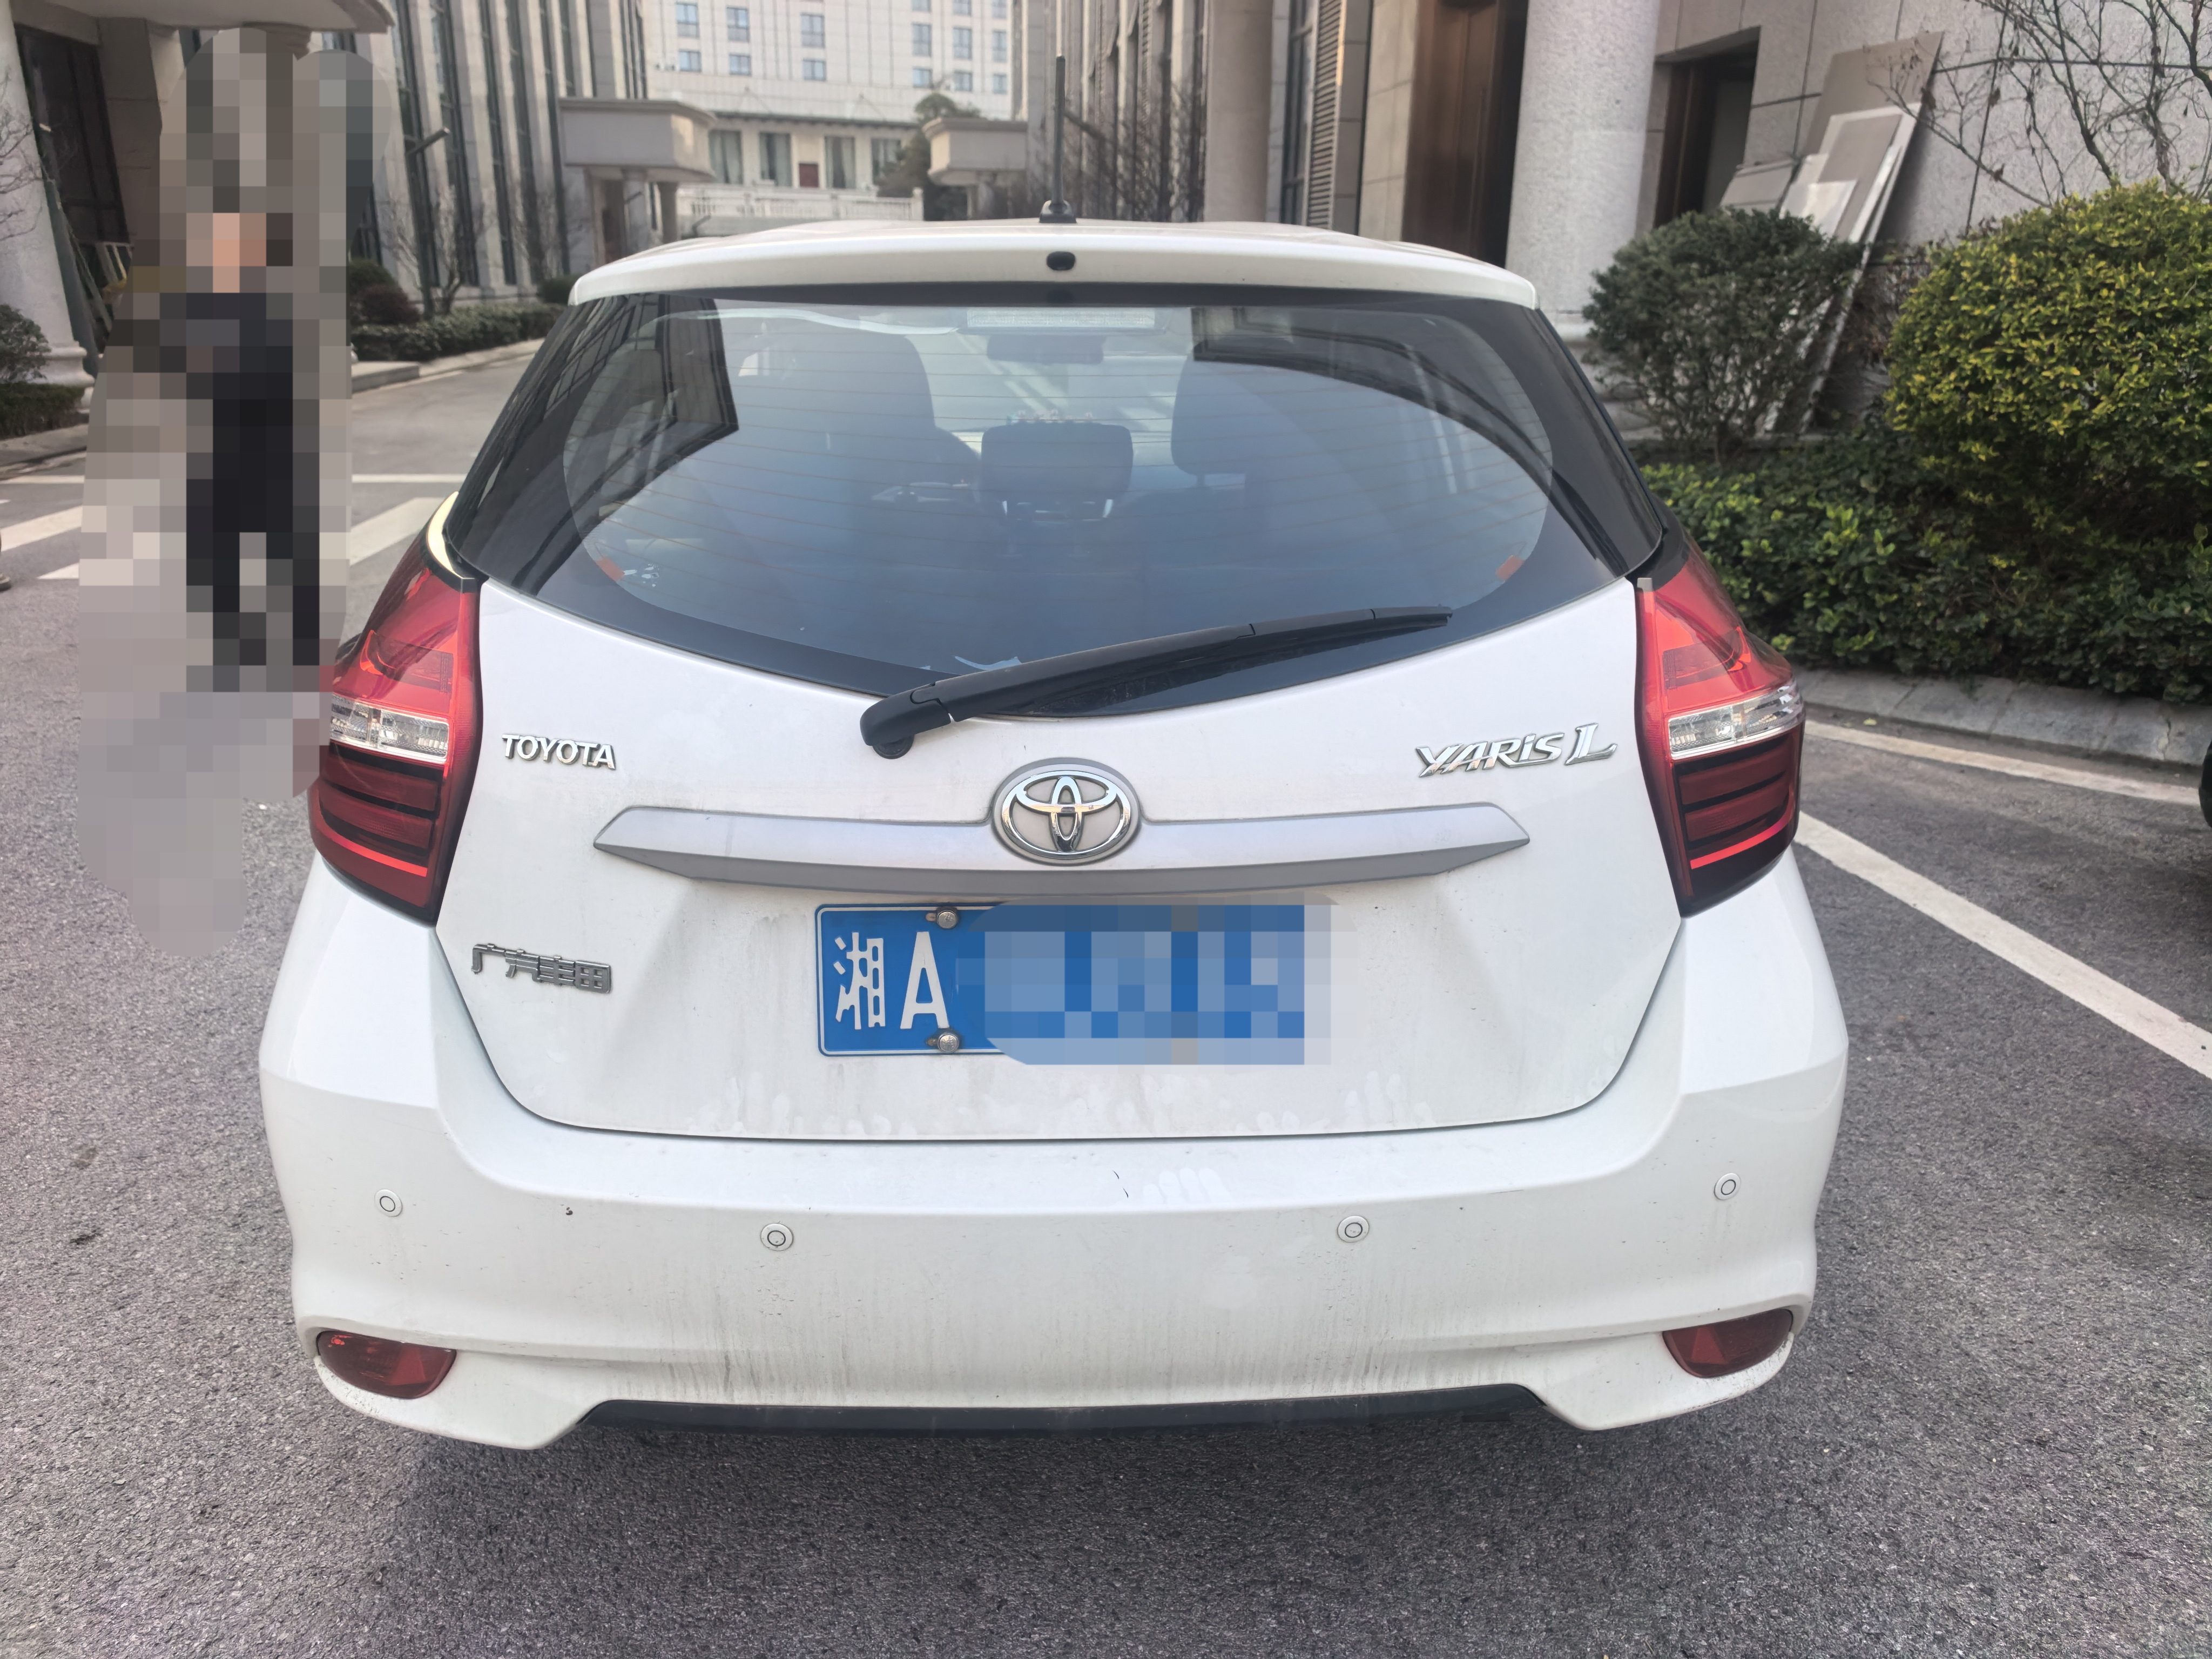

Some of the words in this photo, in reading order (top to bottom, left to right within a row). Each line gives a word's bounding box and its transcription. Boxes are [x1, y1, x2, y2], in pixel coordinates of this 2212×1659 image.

[501, 733, 616, 771] TOYOTA
[1564, 721, 1618, 766] L
[471, 943, 612, 994] 广汽丰田
